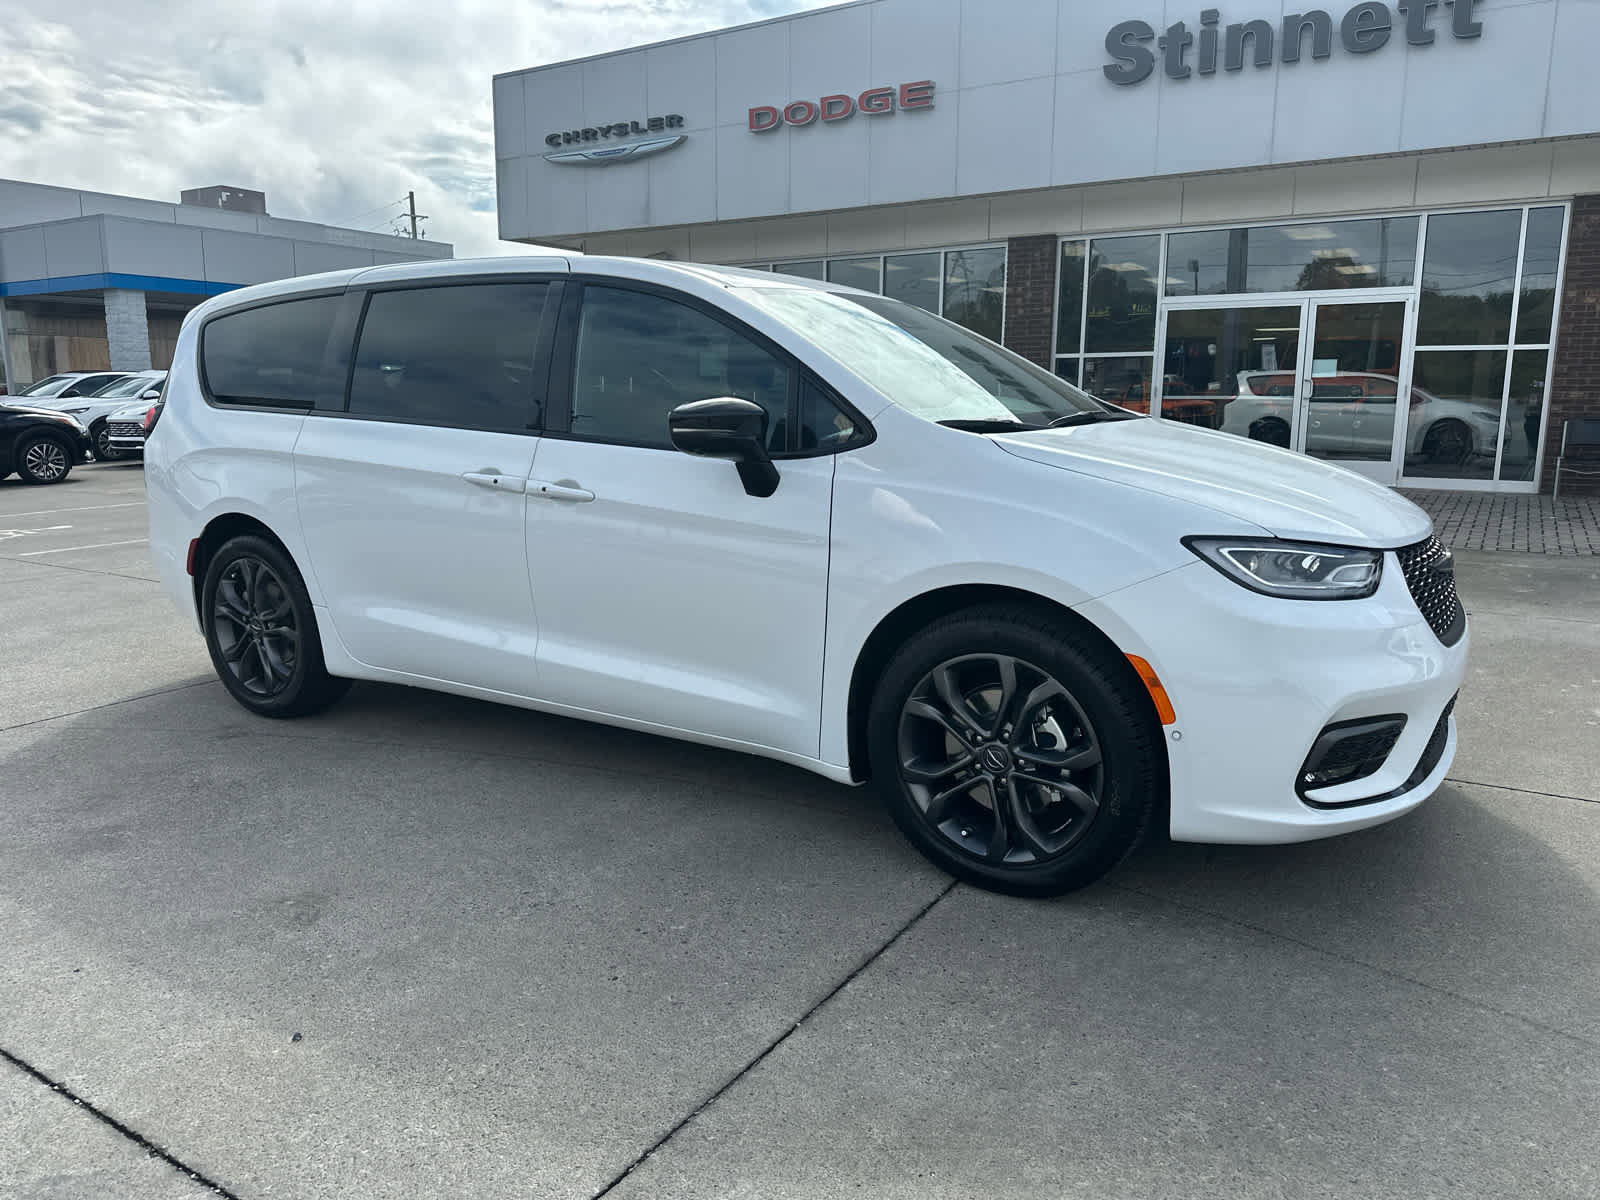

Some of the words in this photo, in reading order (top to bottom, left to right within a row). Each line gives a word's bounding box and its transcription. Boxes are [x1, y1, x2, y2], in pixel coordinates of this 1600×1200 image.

[1103, 0, 1482, 85] Stinnett
[545, 114, 684, 146] CHRYSLER
[749, 80, 935, 132] DODGE
